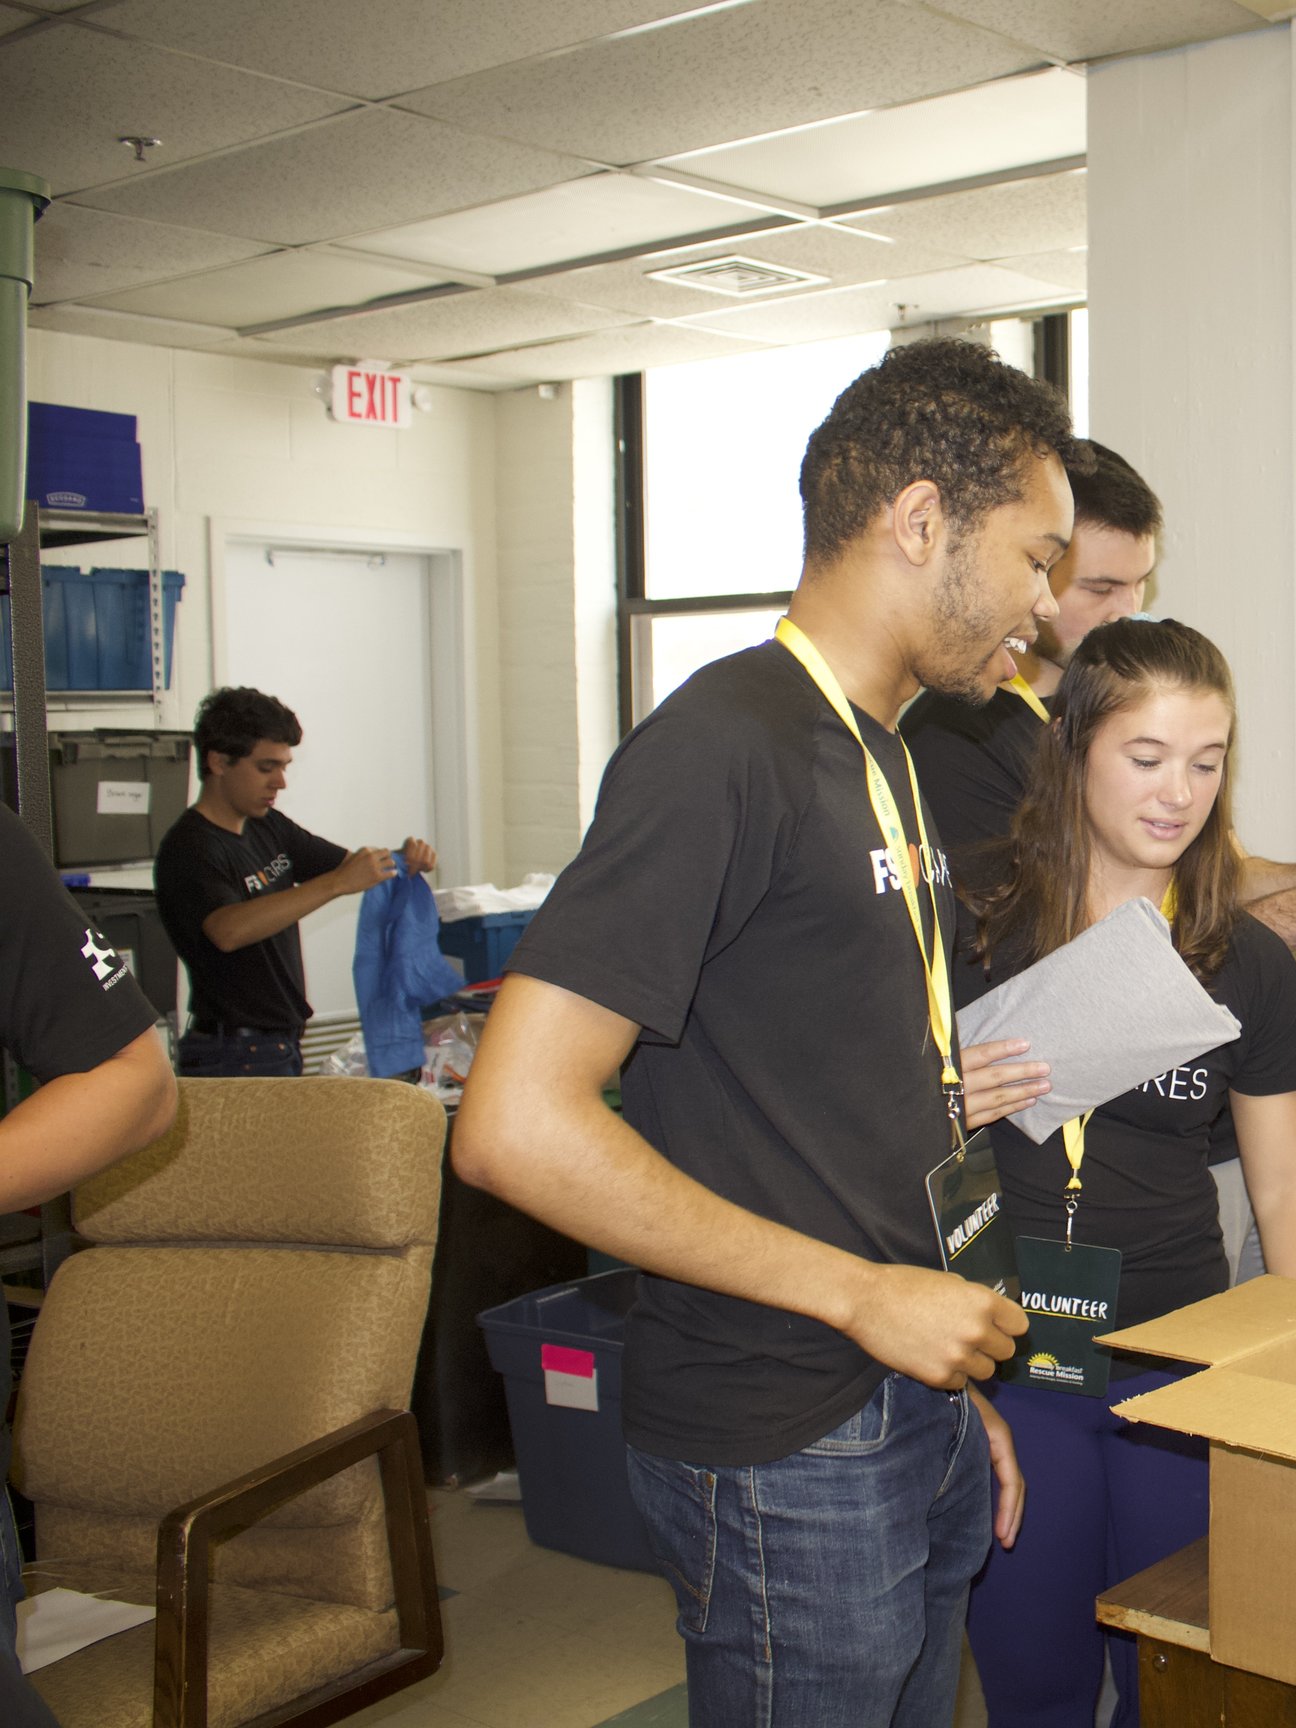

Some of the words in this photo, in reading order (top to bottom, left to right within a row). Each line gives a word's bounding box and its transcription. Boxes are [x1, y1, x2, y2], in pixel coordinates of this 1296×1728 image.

[347, 371, 402, 422] EXIT
[946, 1193, 999, 1254] VOLUNTEER
[1021, 1291, 1108, 1320] VOLUNTEER
[1029, 1366, 1055, 1377] Rescue
[1055, 1370, 1084, 1381] Mission
